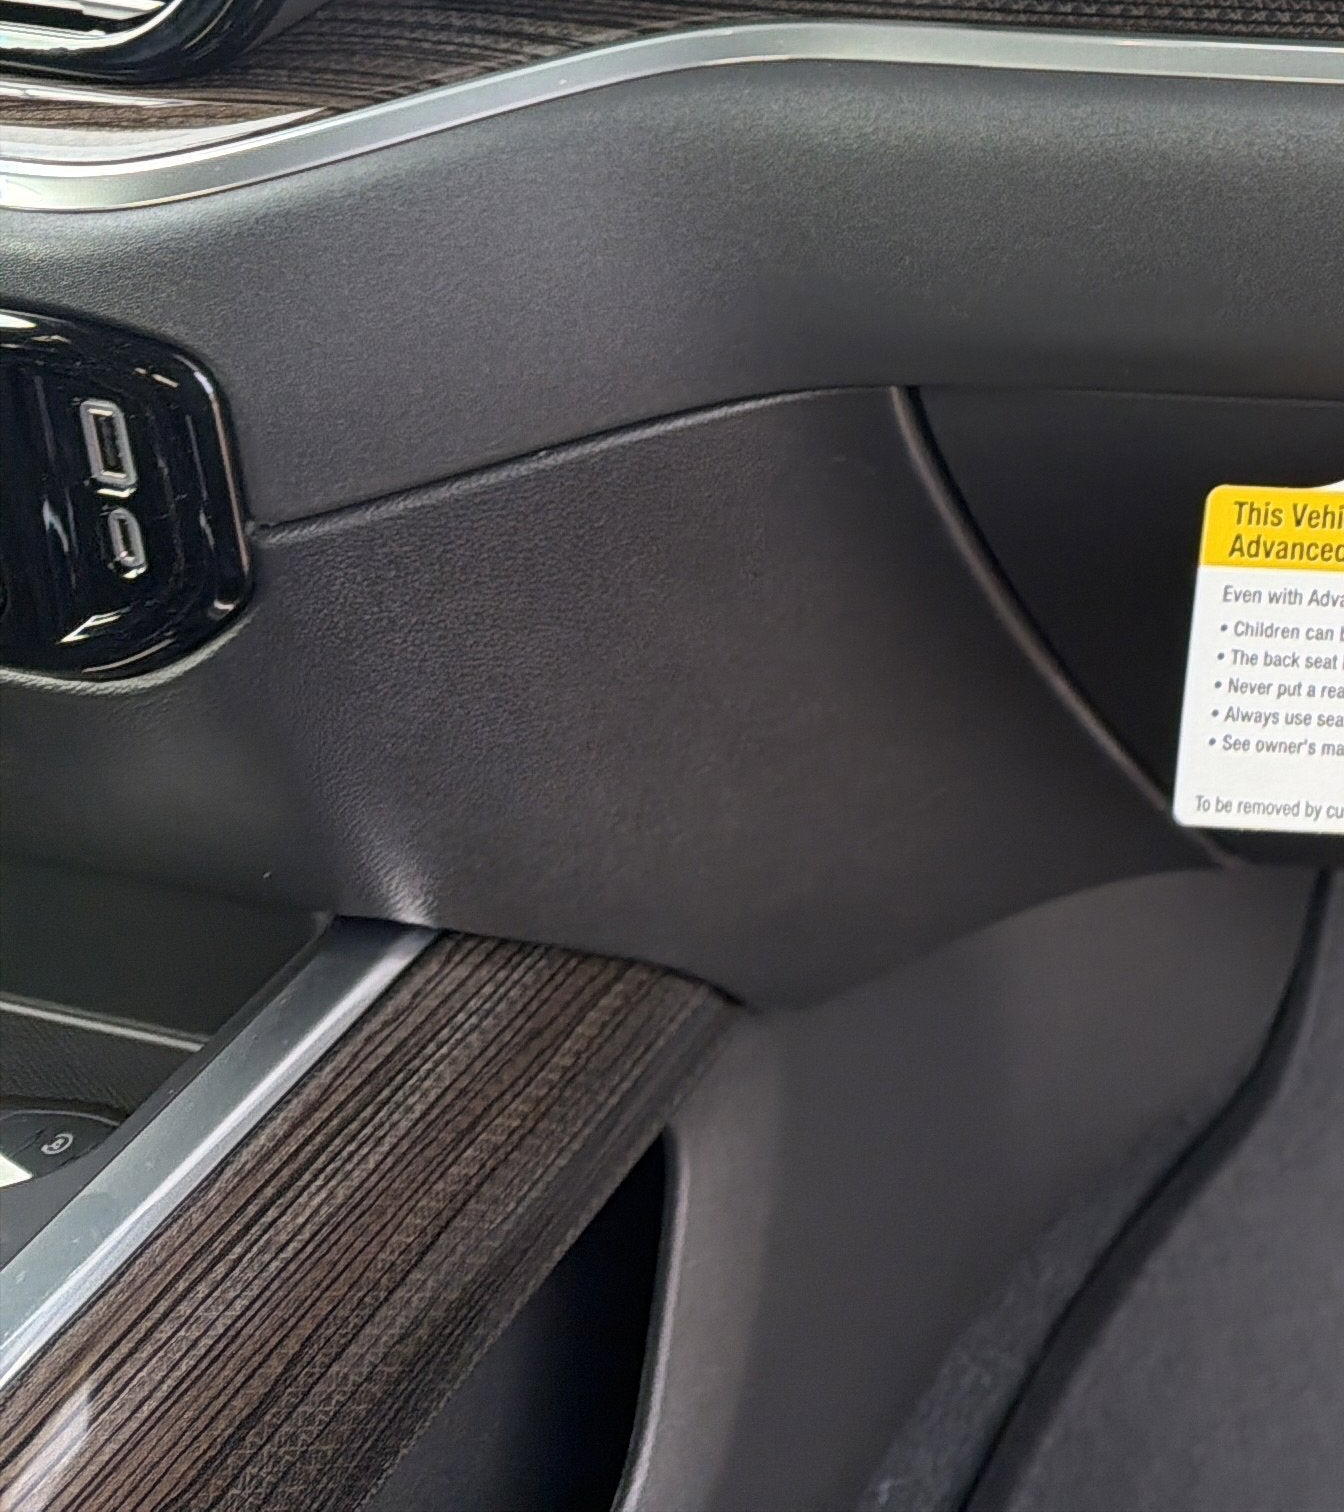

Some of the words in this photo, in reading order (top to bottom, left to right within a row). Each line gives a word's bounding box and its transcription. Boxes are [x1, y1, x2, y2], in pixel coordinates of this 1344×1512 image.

[1234, 500, 1283, 527] This
[1222, 586, 1262, 604] Even
[1268, 588, 1303, 606] with
[1234, 620, 1300, 639] Children
[1305, 627, 1334, 641] can
[1231, 648, 1259, 667] The
[1263, 650, 1300, 668] back
[1305, 654, 1338, 670] seat
[1228, 677, 1273, 695] Never
[1276, 681, 1303, 700] put
[1306, 684, 1316, 698] a
[1223, 706, 1280, 728] Always
[1284, 712, 1312, 727] use
[1222, 734, 1251, 752] See
[1255, 739, 1316, 756] owner's
[1196, 795, 1211, 812] To
[1215, 796, 1233, 814] be
[1237, 800, 1300, 817] removed
[1305, 801, 1322, 822] by
